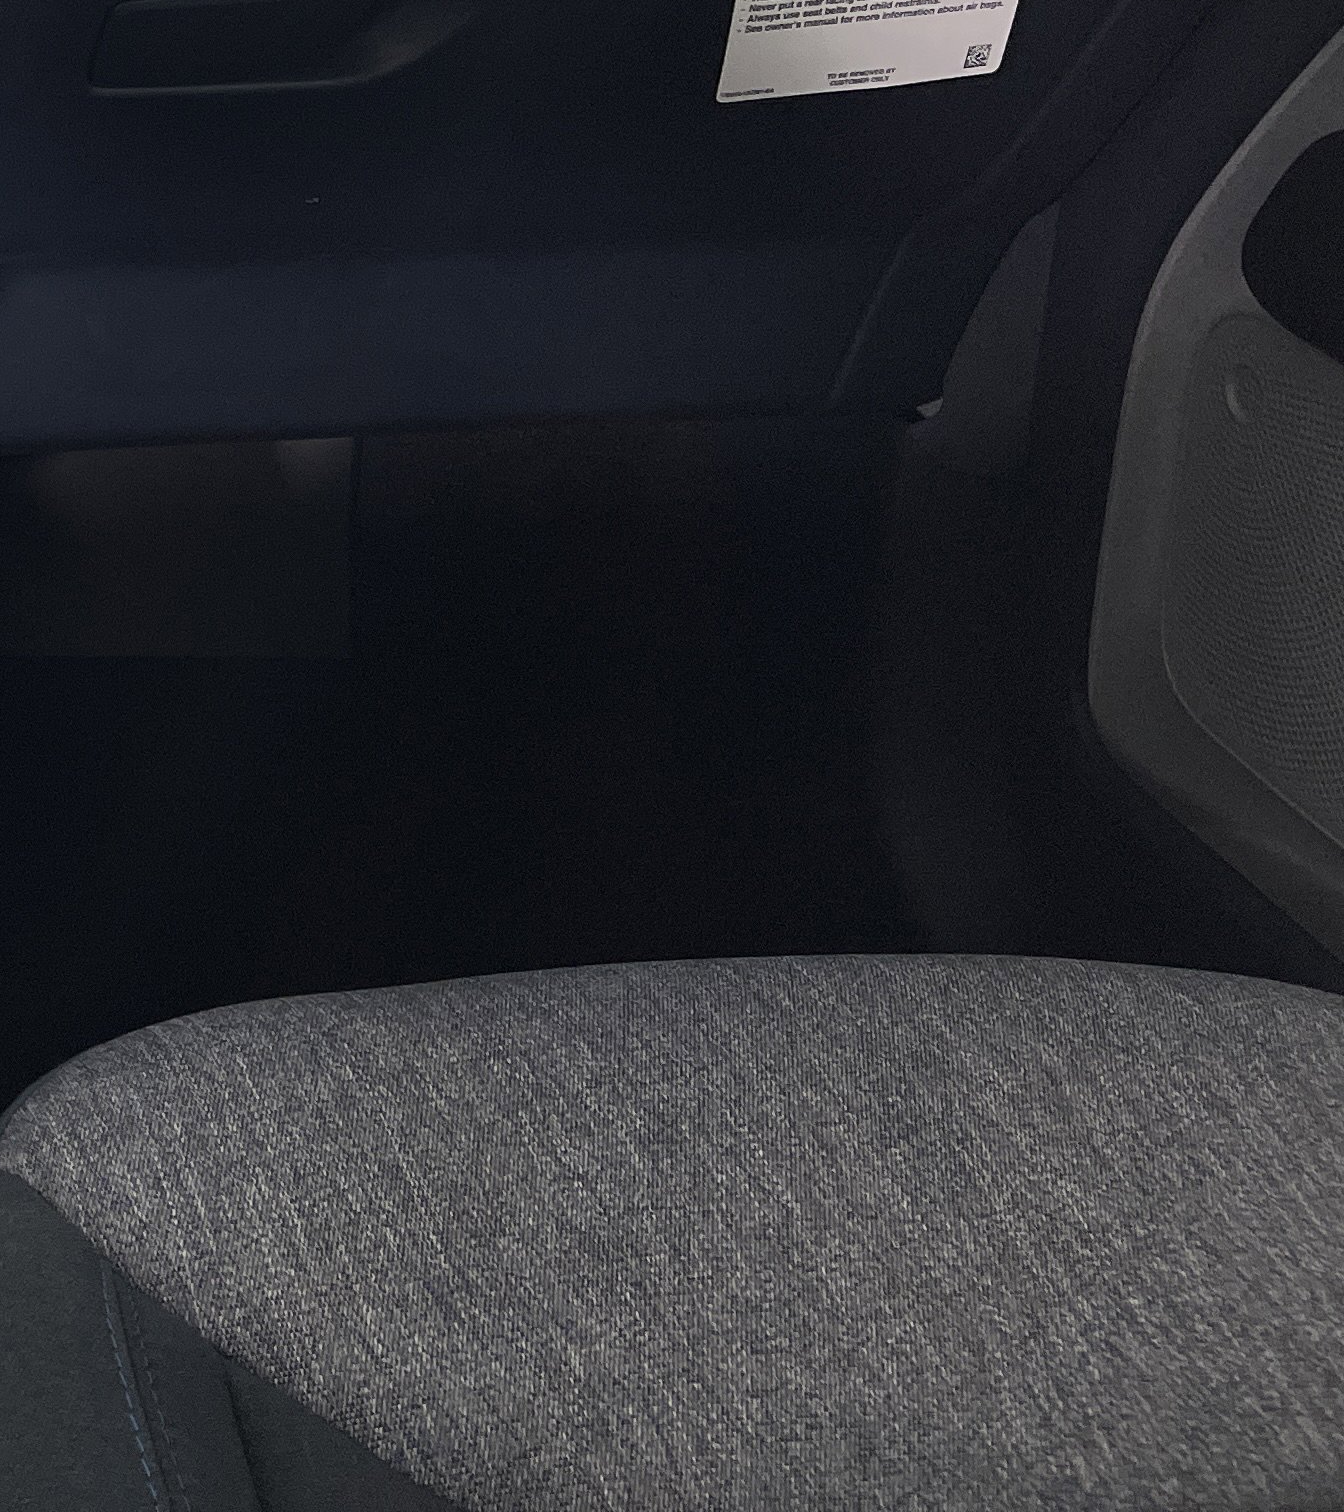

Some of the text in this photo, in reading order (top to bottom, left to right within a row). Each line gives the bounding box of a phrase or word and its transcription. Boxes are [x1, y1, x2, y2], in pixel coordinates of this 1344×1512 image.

[747, 13, 781, 23] Always
[783, 11, 800, 19] use
[803, 9, 822, 17] seat
[850, 4, 868, 12] and
[870, 1, 893, 10] child
[749, 3, 777, 12] Never
[778, 1, 794, 11] put
[804, 16, 838, 27] manual
[840, 15, 853, 24] for
[855, 13, 880, 22] more
[882, 8, 935, 20] information
[937, 5, 963, 14] about
